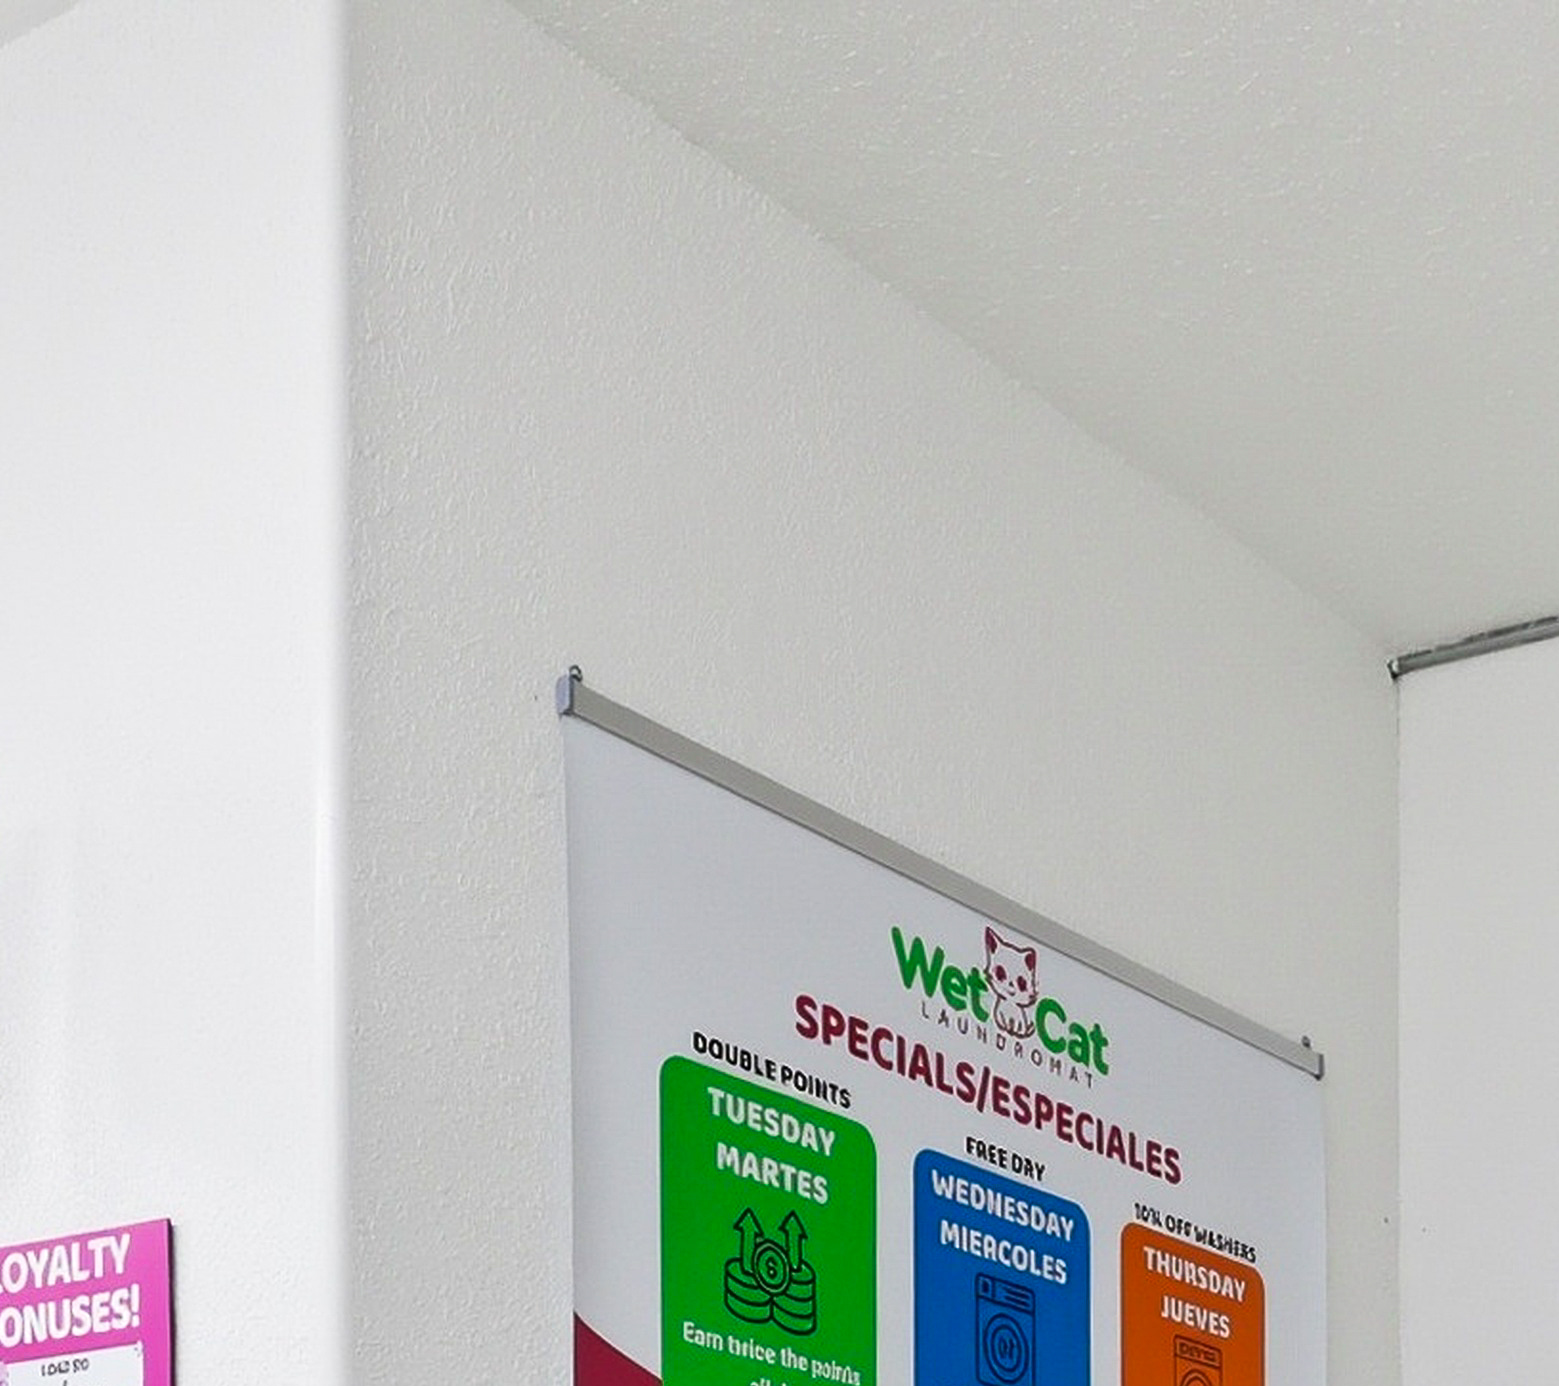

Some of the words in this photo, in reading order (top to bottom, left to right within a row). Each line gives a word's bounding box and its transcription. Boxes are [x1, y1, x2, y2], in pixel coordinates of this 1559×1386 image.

[891, 925, 989, 1022] Wet
[1036, 998, 1109, 1076] Cat
[693, 1031, 776, 1081] DOUBLE
[780, 1065, 851, 1109] POINTS
[921, 1001, 1093, 1089] LAUNDROMAT
[706, 1085, 836, 1157] TUESDAY
[795, 994, 1182, 1186] SPECIALS/ESPECIALES
[716, 1141, 829, 1206] MARTES
[965, 1136, 1007, 1169] FREE
[1011, 1152, 1046, 1182] DRY
[931, 1168, 1075, 1243] WEDNESDAY
[1142, 1246, 1246, 1302] THURSDAY
[1193, 1223, 1257, 1264] WASHERS
[1161, 1295, 1232, 1339] JUEVES
[682, 1320, 724, 1352] Earn
[727, 1335, 777, 1365] twice
[780, 1347, 808, 1372] the
[811, 1358, 861, 1386] points
